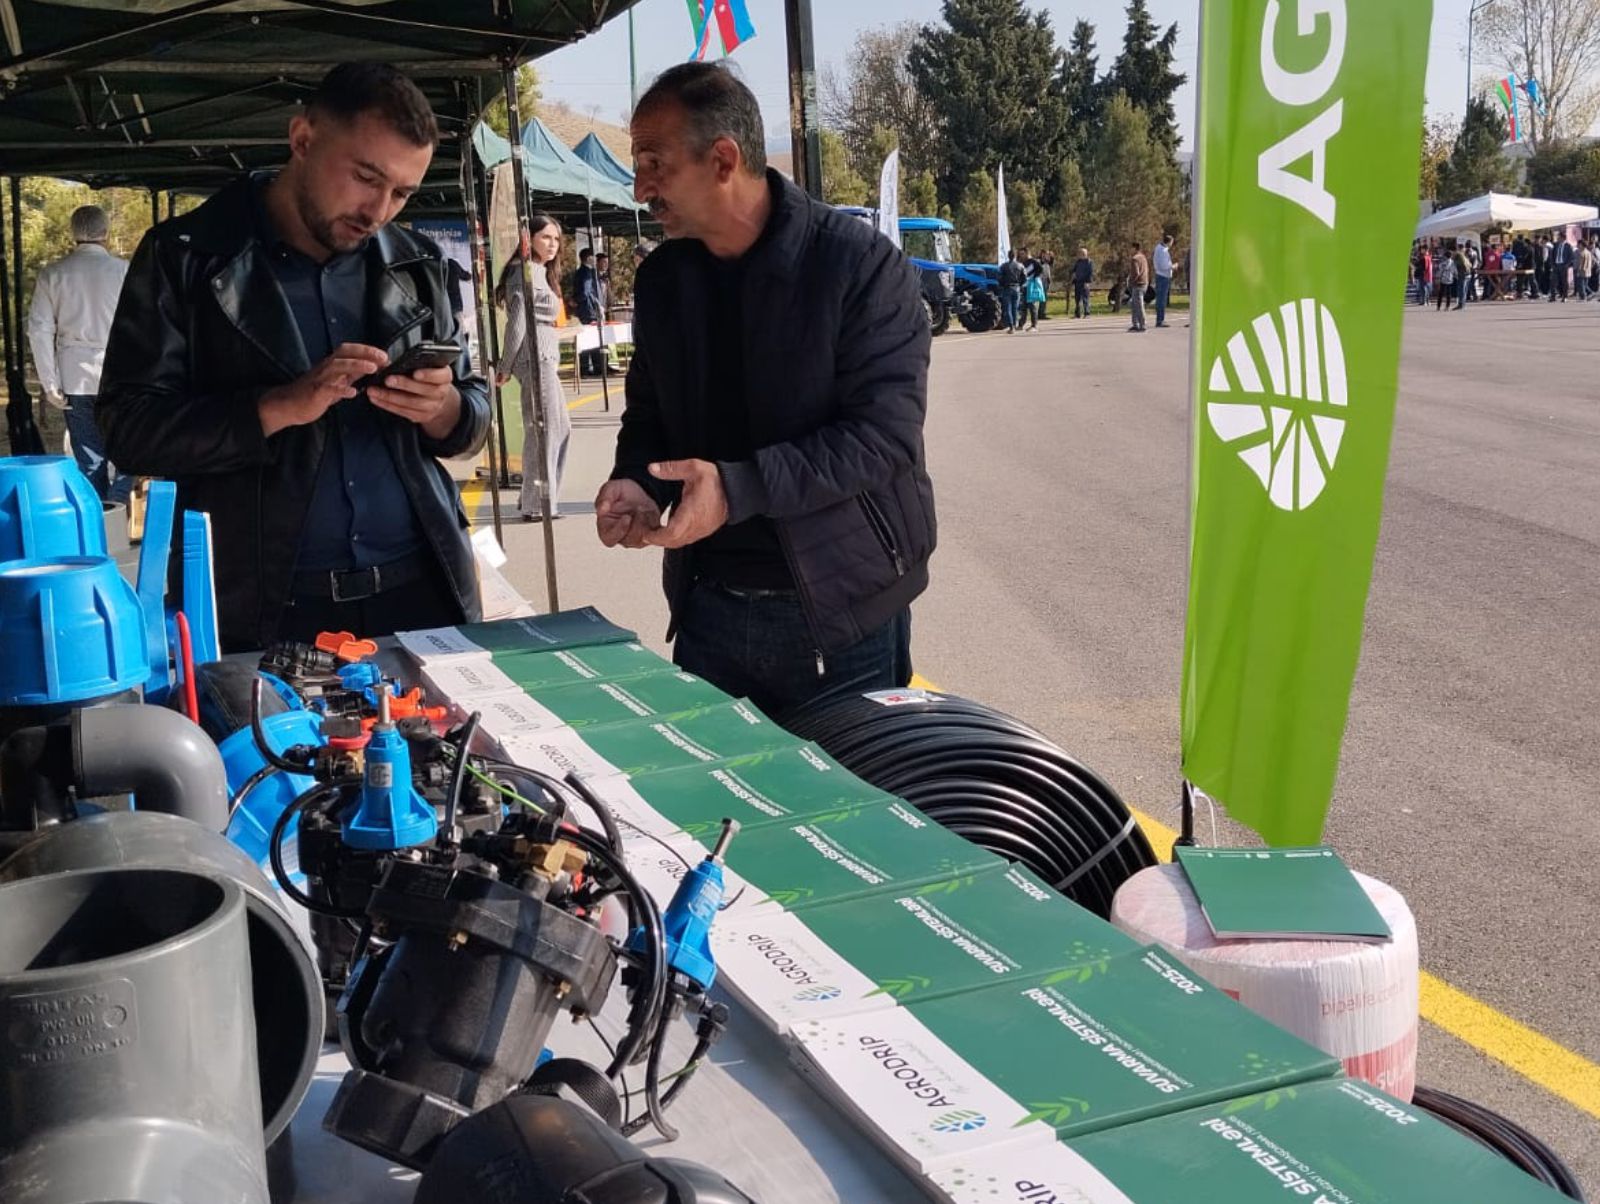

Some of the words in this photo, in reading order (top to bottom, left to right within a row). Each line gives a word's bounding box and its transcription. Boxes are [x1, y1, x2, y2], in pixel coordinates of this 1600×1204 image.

[1258, 0, 1347, 230] AG
[1161, 969, 1204, 995] 2025
[858, 1035, 955, 1108] AGRODRİP
[1101, 1042, 1181, 1094] SUVARMA
[1363, 1097, 1419, 1125] 2025
